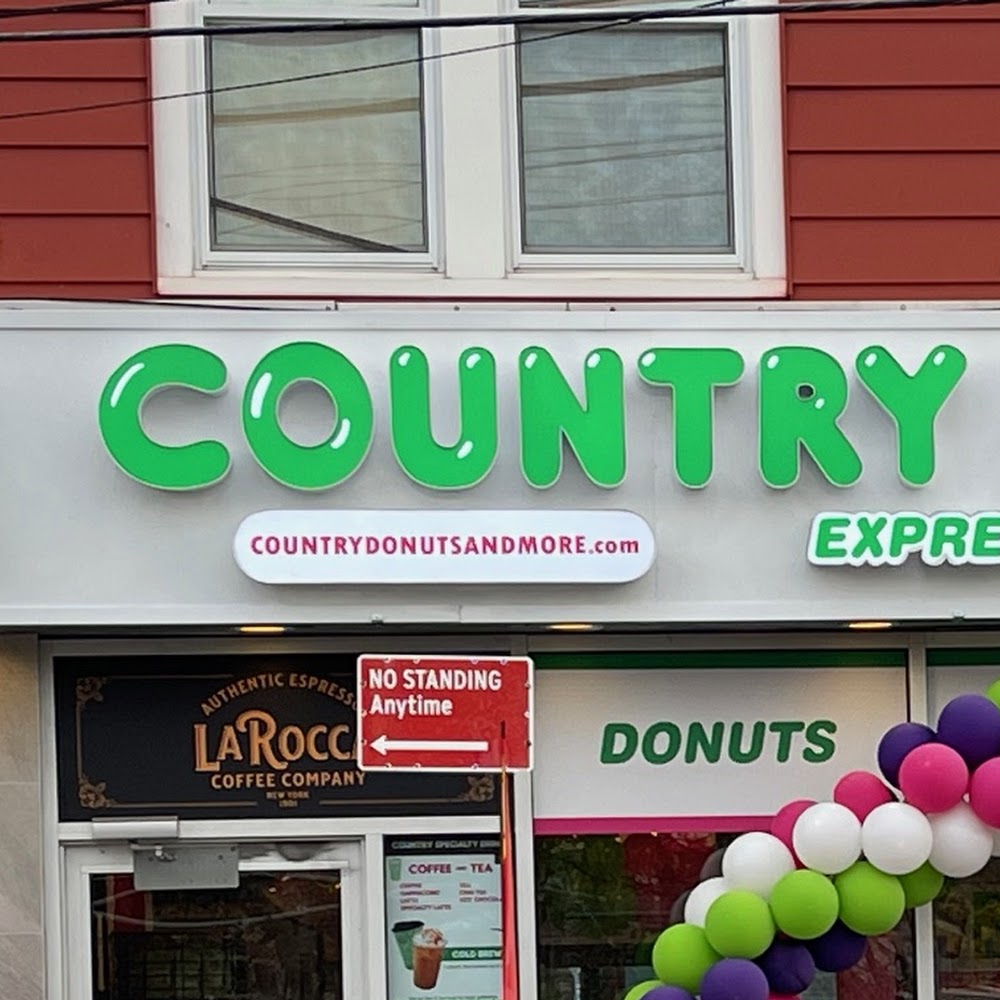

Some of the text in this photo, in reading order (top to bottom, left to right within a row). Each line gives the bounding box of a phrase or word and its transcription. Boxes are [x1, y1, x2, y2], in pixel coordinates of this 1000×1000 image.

[98, 340, 968, 491] COUNTRY
[249, 533, 640, 558] COUNTRYDONUTSANDMORE.com
[368, 668, 502, 691] NO STANDING
[201, 673, 285, 717] AUTHENTIC
[370, 694, 454, 720] Anytime
[193, 709, 358, 772] LAROCC
[599, 719, 838, 765] DONUTS
[211, 771, 367, 790] COFFEE COMPANY
[408, 863, 493, 874] COFFEE TEA
